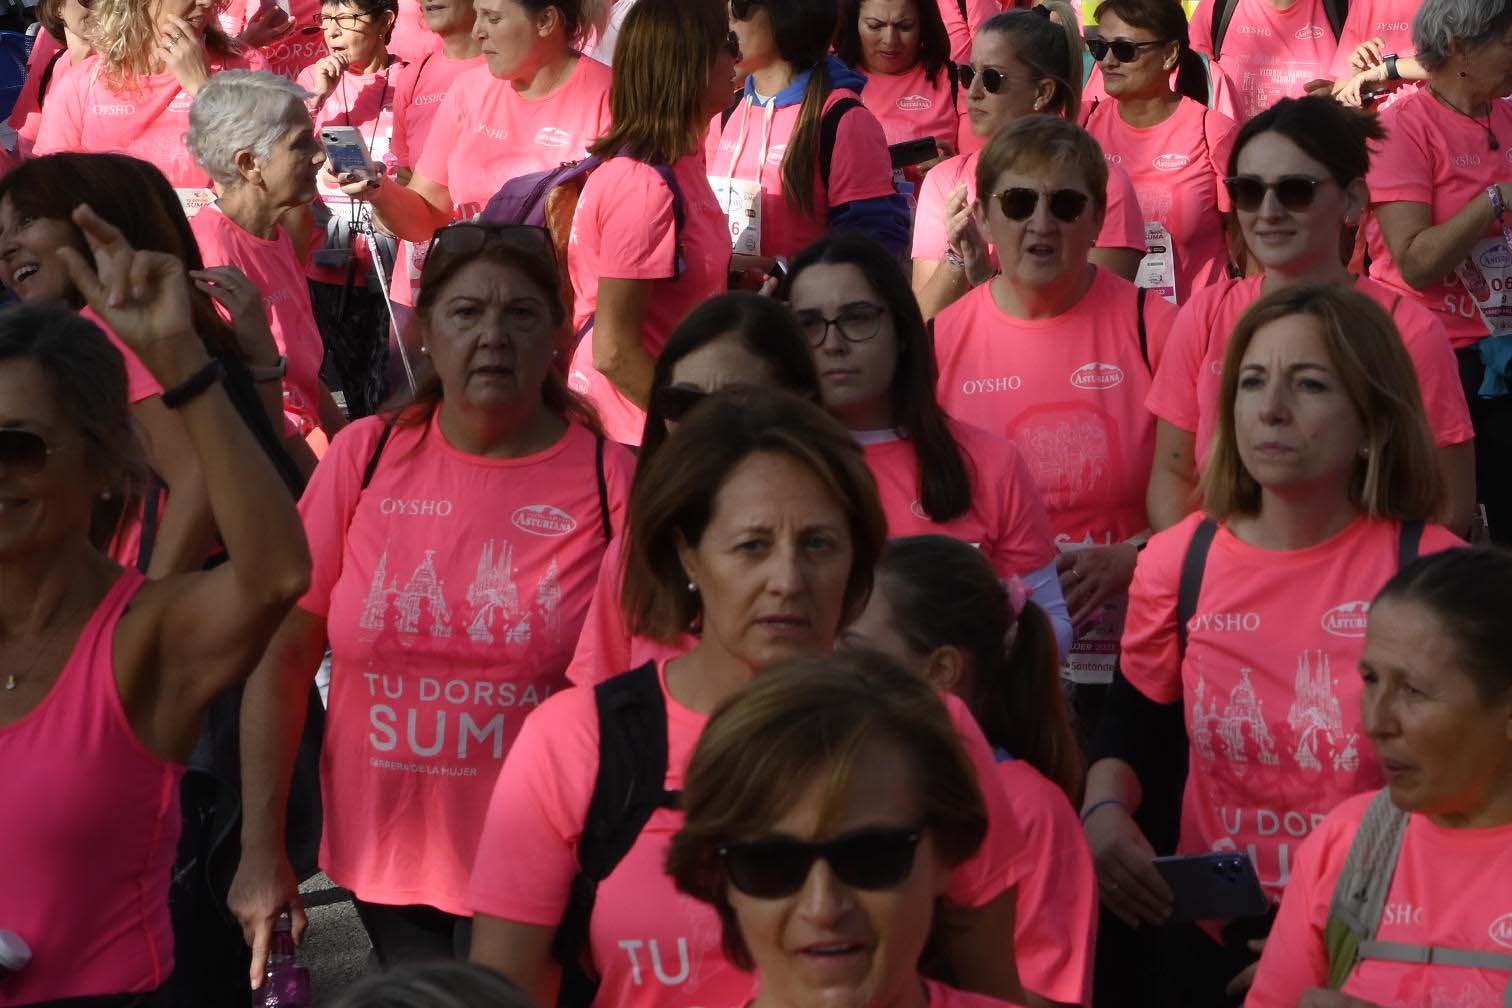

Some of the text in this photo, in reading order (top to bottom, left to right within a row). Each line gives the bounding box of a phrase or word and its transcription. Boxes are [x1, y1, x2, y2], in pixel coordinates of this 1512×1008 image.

[1236, 24, 1272, 37] OYSHO
[962, 376, 1022, 395] OYSHO
[1075, 371, 1121, 384] ASTURIANA
[380, 498, 453, 516] OYSHO
[363, 673, 403, 699] TU
[370, 703, 505, 759] SUM
[618, 938, 690, 986] TU
